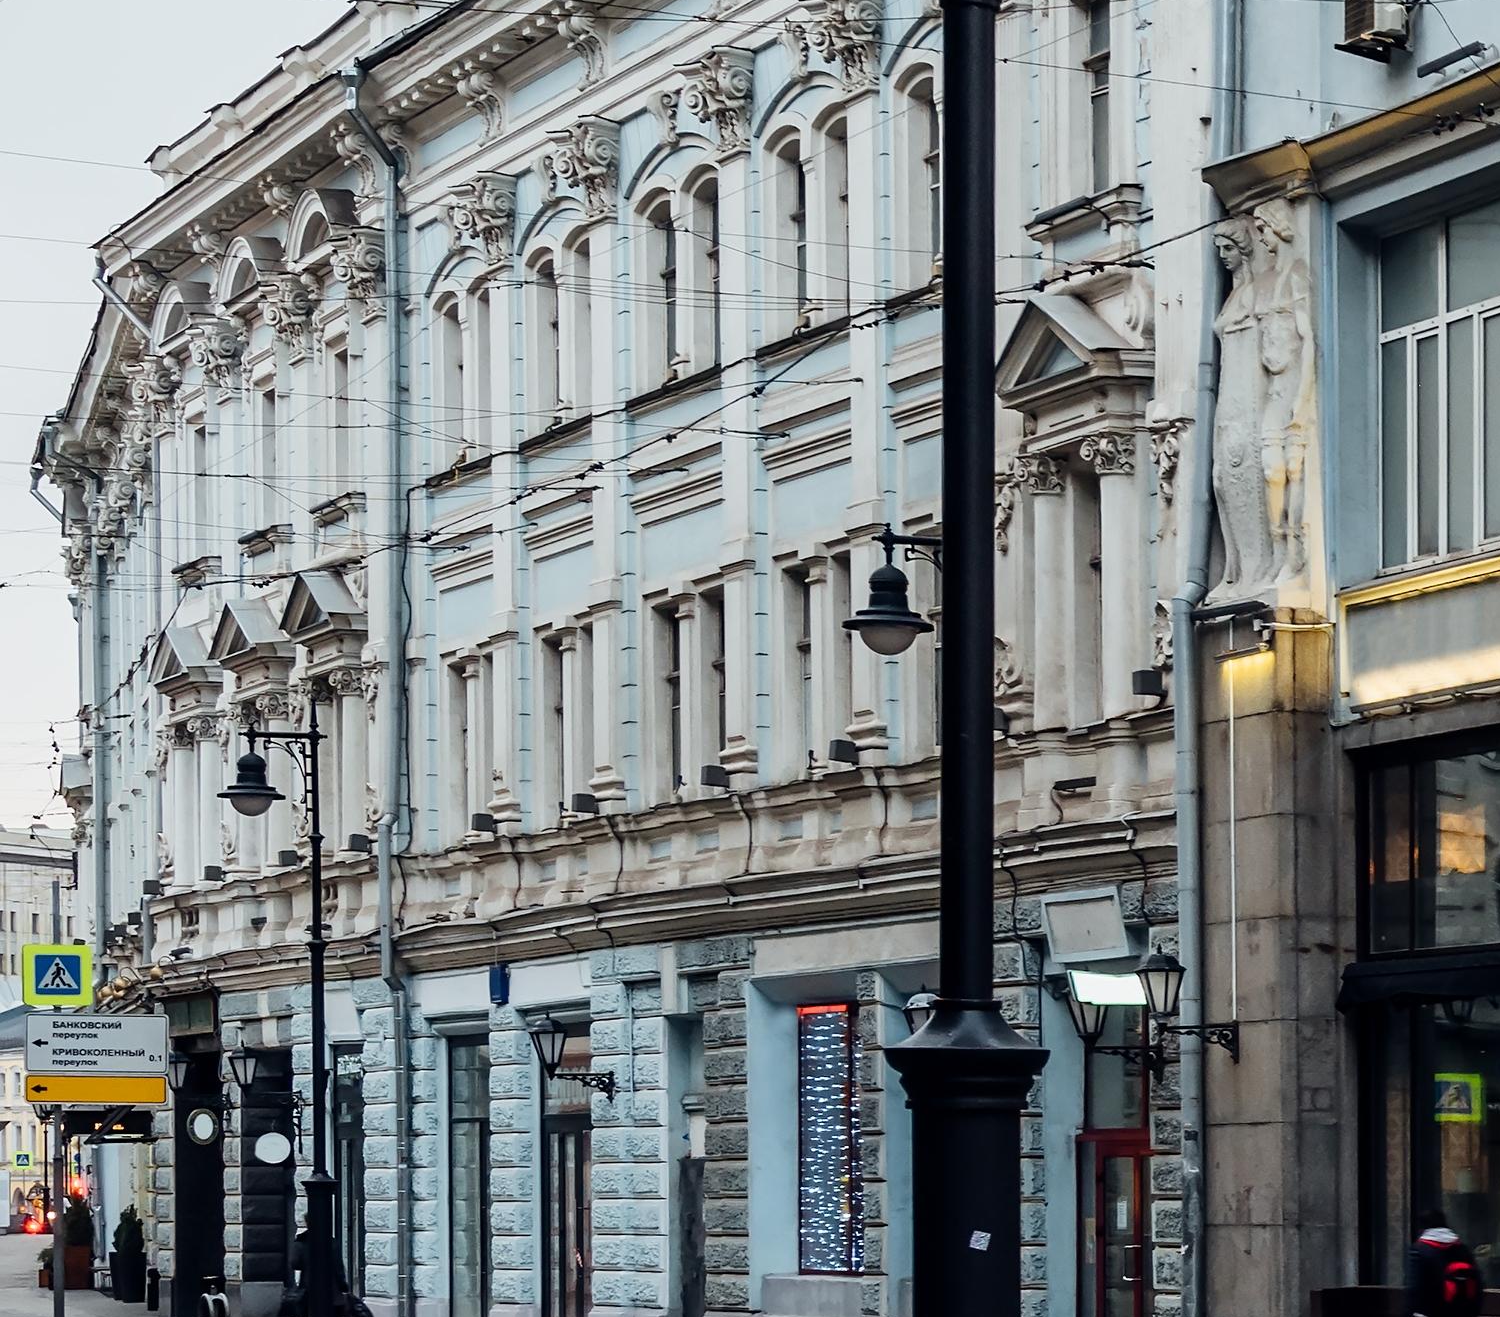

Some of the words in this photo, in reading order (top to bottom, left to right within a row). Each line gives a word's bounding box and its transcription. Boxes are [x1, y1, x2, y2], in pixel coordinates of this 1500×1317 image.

[52, 1021, 122, 1030] БАНКОВСКИЙ
[52, 1032, 99, 1040] переулок
[52, 1048, 146, 1057] КРИВОКОЛЕННЫЙ
[149, 1054, 162, 1062] 0.1
[52, 1059, 98, 1067] переулок
